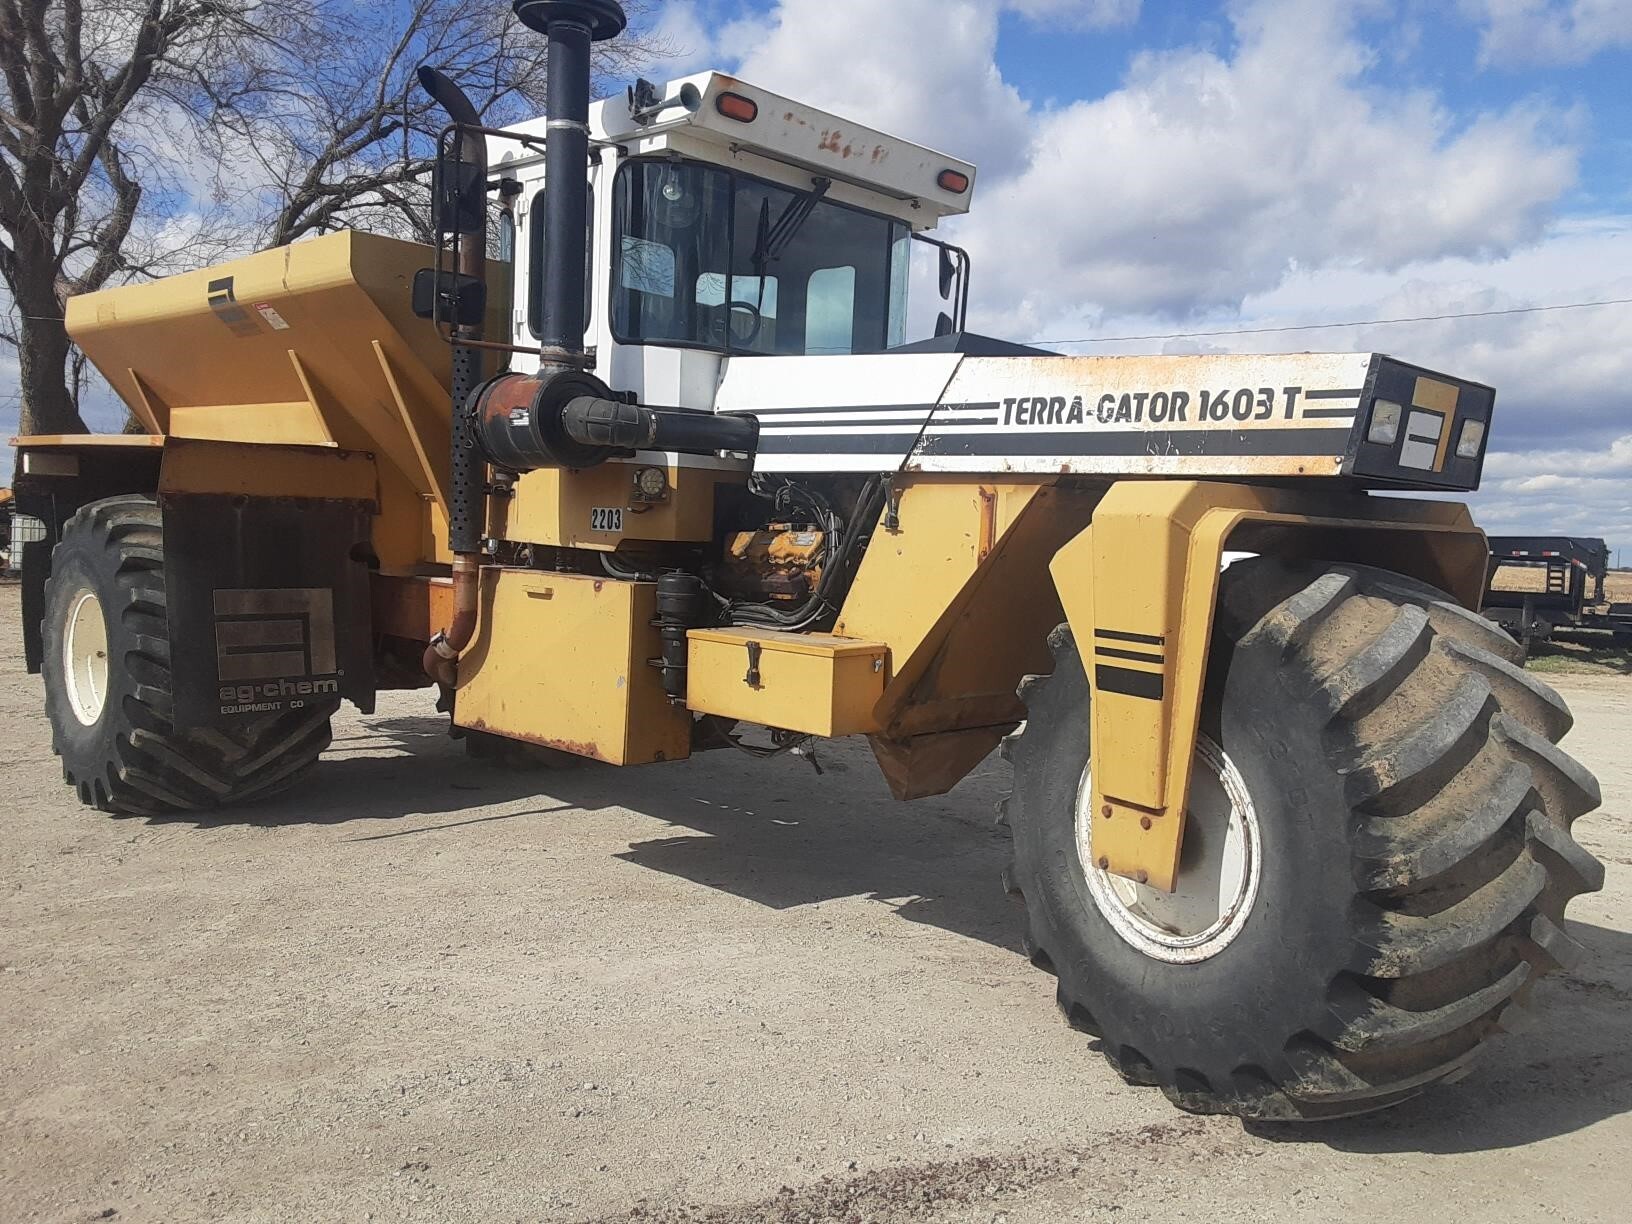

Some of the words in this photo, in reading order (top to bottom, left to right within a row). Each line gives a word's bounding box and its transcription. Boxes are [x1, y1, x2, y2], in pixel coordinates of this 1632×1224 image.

[1003, 391, 1190, 425] TERRA-GATOR
[1198, 388, 1275, 422] 1603
[591, 508, 621, 530] 2203
[220, 702, 281, 715] EQUIPMENT
[290, 700, 304, 709] CO
